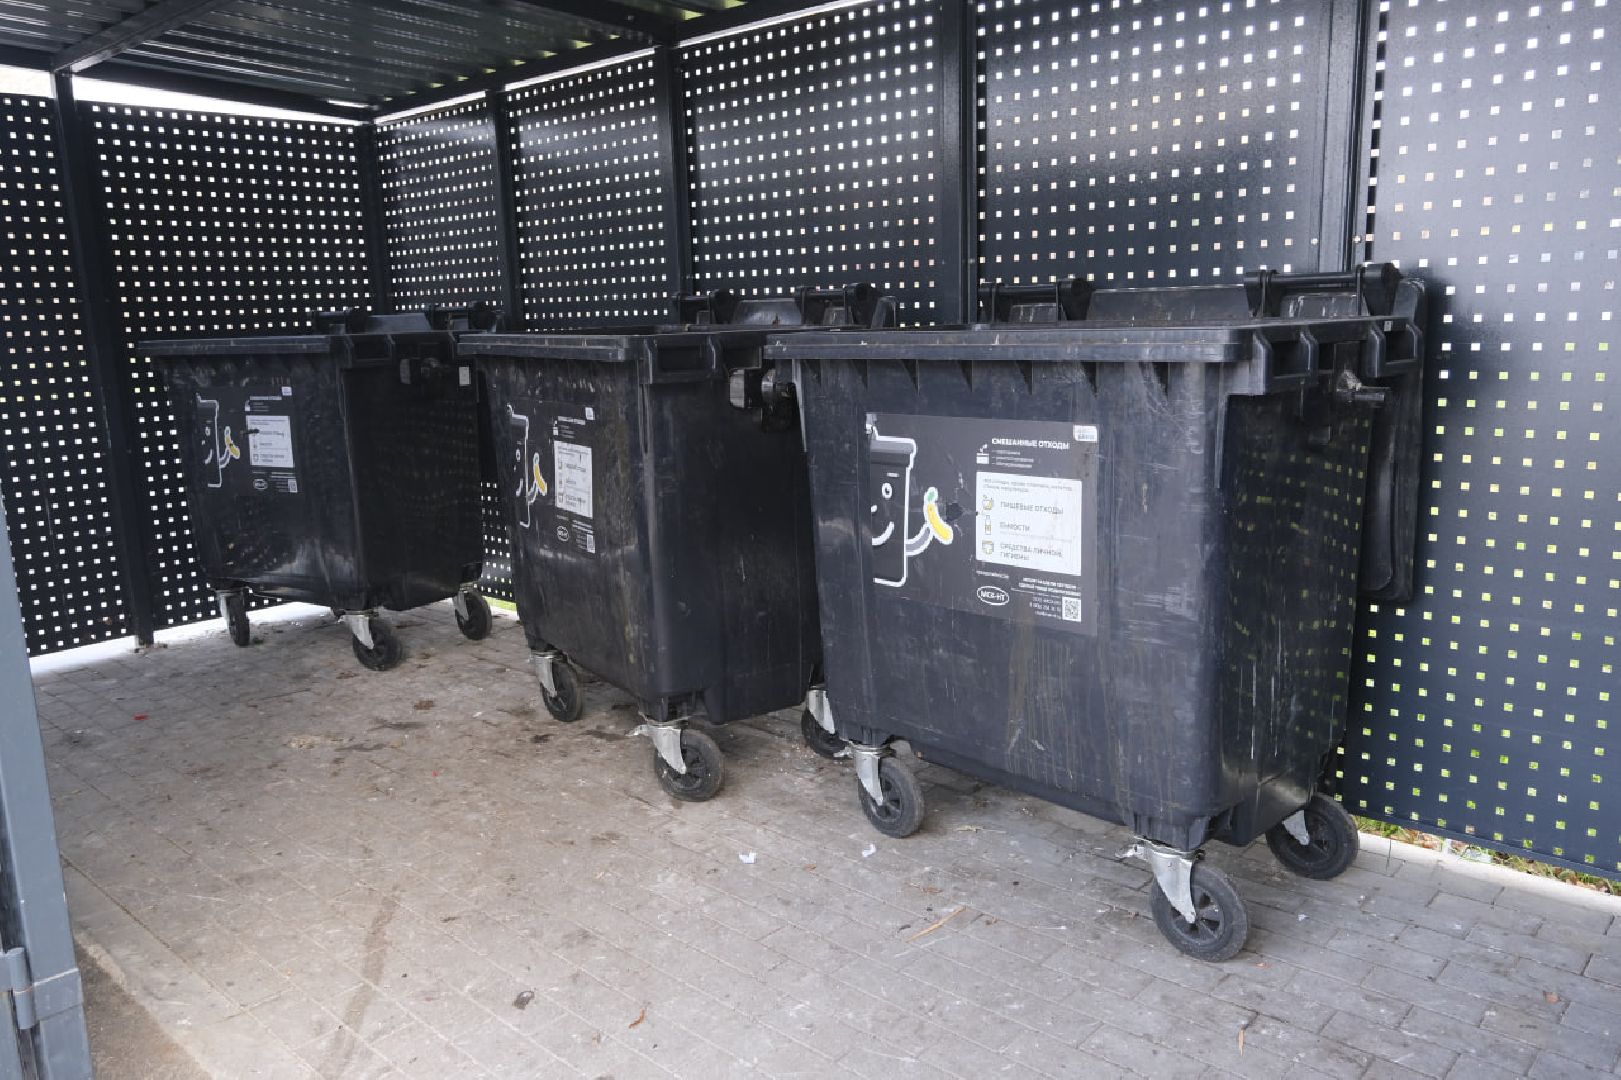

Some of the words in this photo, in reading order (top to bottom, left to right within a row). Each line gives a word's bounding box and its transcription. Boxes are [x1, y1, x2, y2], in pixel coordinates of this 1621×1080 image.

[991, 438, 1038, 447] СМЕШАННЫЕ
[1038, 440, 1070, 450] ОТХОДЫ
[1000, 501, 1034, 511] ПИЩЕВЫЕ
[1034, 505, 1064, 515] ОТХОДЫ
